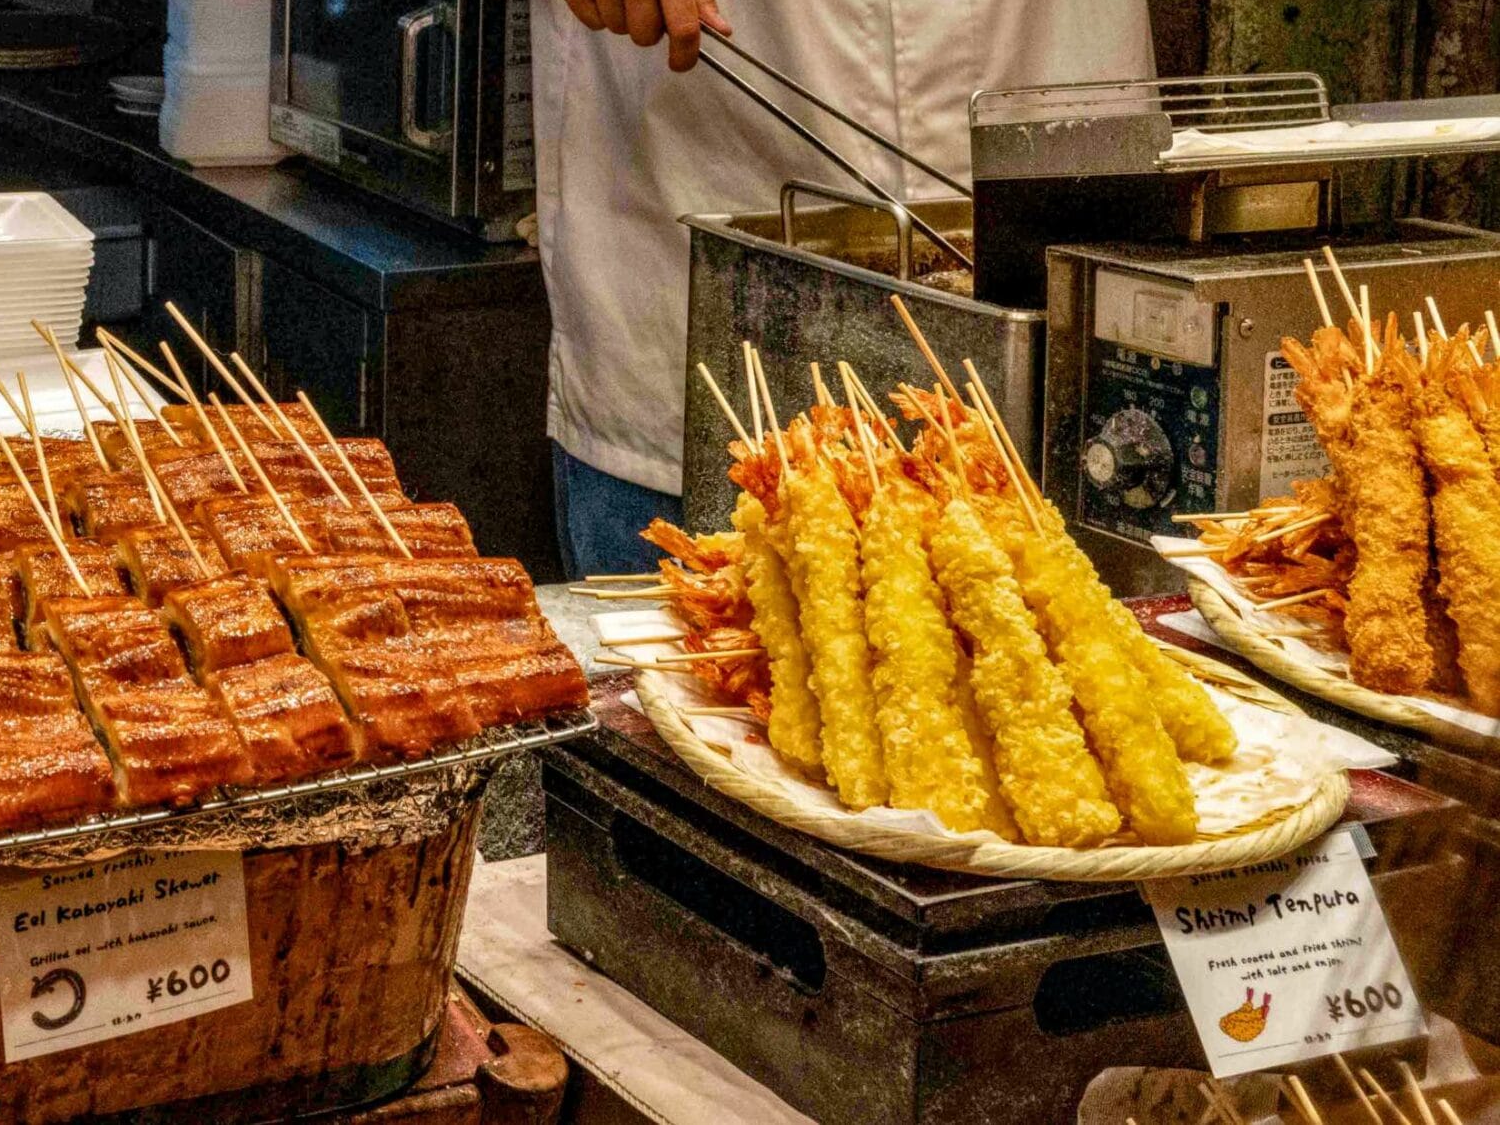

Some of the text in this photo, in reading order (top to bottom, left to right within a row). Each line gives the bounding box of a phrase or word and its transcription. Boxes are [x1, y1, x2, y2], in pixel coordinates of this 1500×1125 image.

[14, 872, 221, 933] Eel Kabayaki Skewer
[1176, 904, 1257, 934] Shrimp
[30, 950, 70, 967] Grilled
[75, 946, 91, 956] eel
[97, 937, 123, 952] with
[1208, 957, 1237, 971] Fresh
[1241, 950, 1275, 964] coated
[1279, 948, 1298, 958] and
[146, 958, 231, 1003] ¥600
[1240, 968, 1263, 981] with
[1267, 964, 1287, 976] salt
[1292, 961, 1311, 972] and
[1325, 981, 1402, 1023] ¥600
